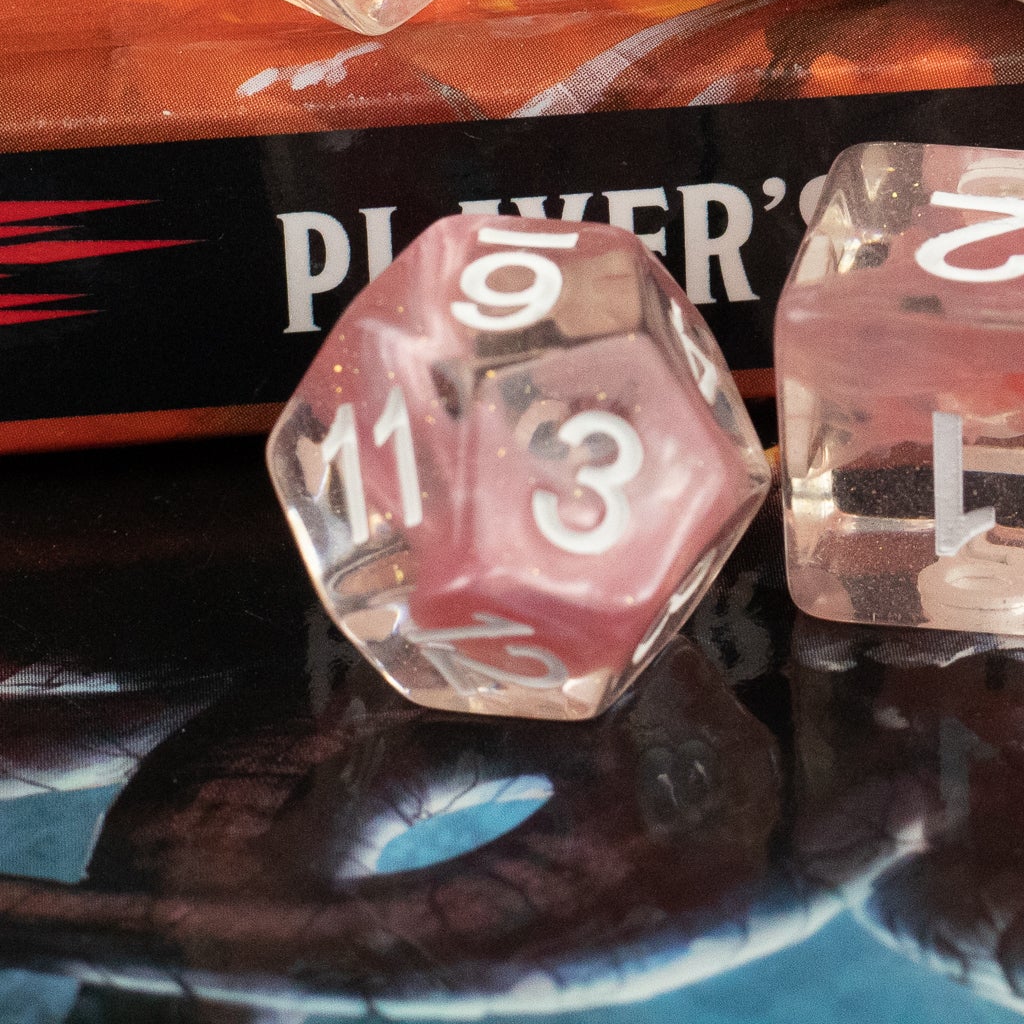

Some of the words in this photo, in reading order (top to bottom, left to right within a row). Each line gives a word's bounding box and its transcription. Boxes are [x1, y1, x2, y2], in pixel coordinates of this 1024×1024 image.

[322, 386, 423, 545] 11
[532, 410, 644, 555] 3
[932, 412, 996, 557] 1
